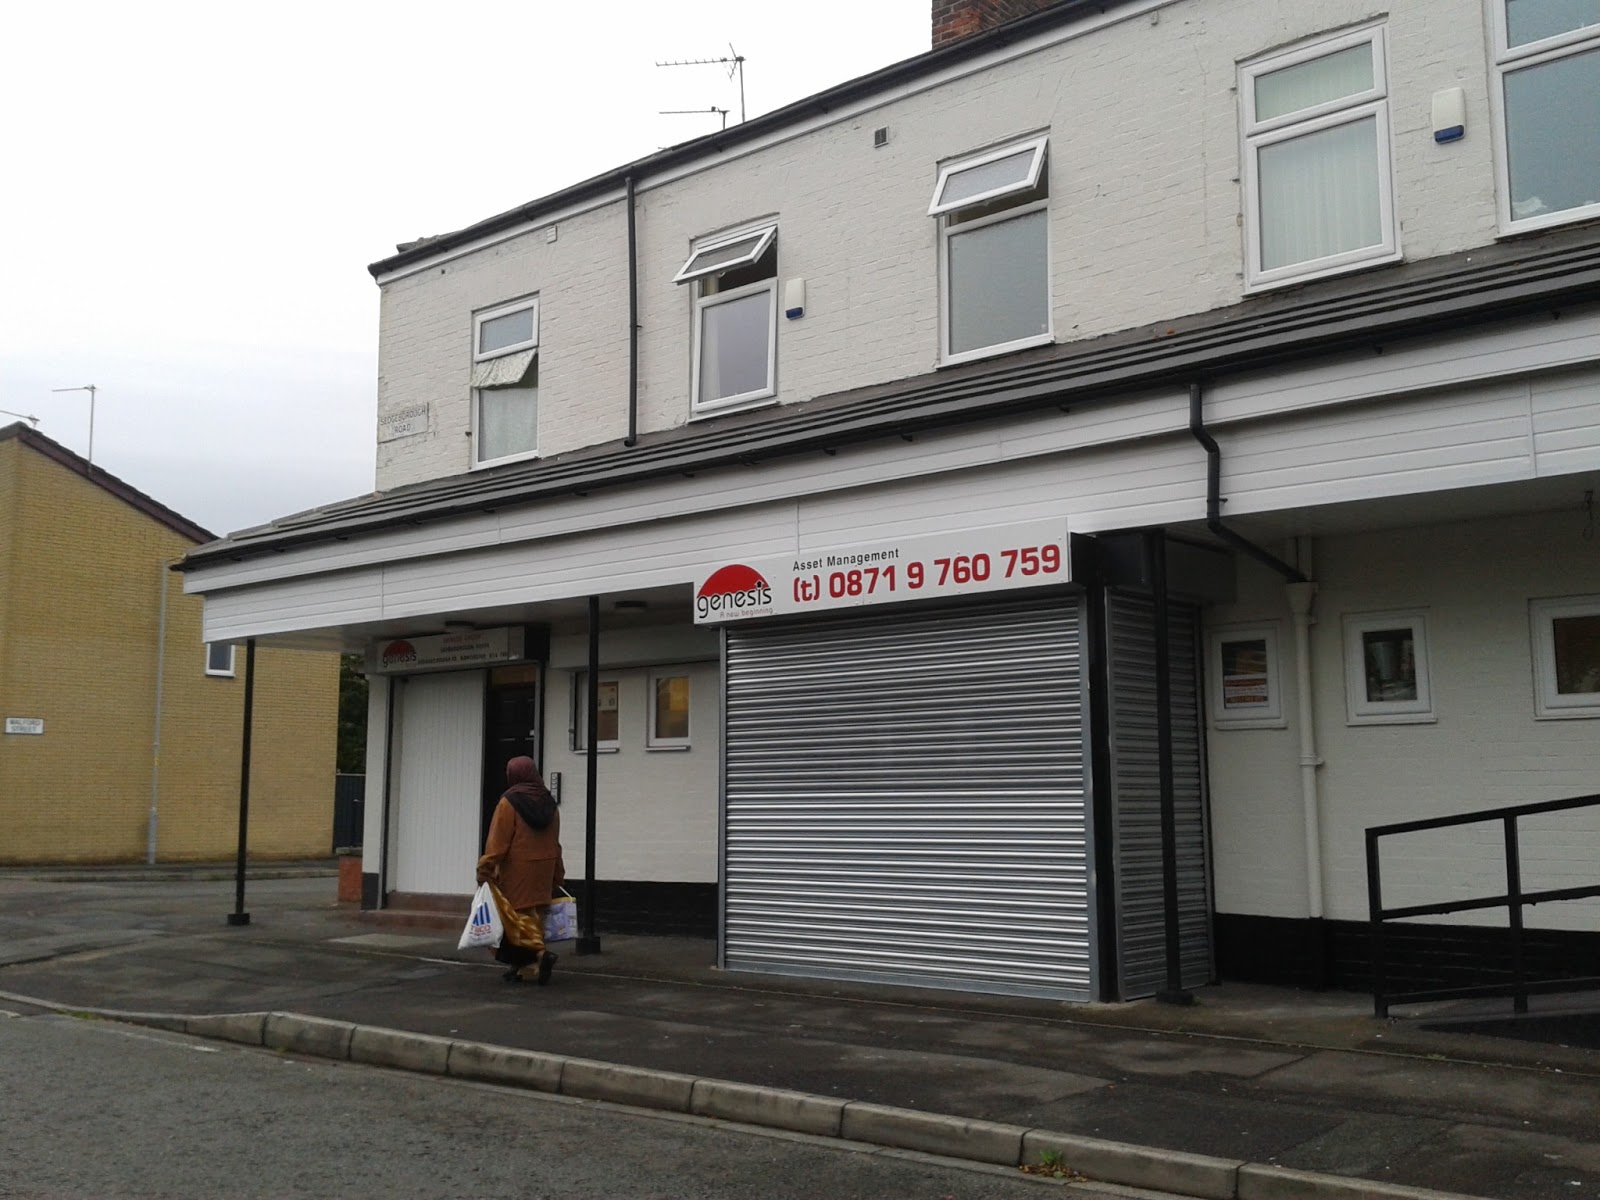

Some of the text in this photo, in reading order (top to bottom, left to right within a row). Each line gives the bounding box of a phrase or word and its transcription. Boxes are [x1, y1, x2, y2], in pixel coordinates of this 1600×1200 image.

[394, 423, 411, 433] ROAD
[793, 548, 899, 571] Asset Management
[793, 544, 1061, 602] (t) 0871 9 760 759
[697, 581, 772, 619] genesis
[741, 606, 773, 617] beginning
[383, 650, 417, 668] genesis
